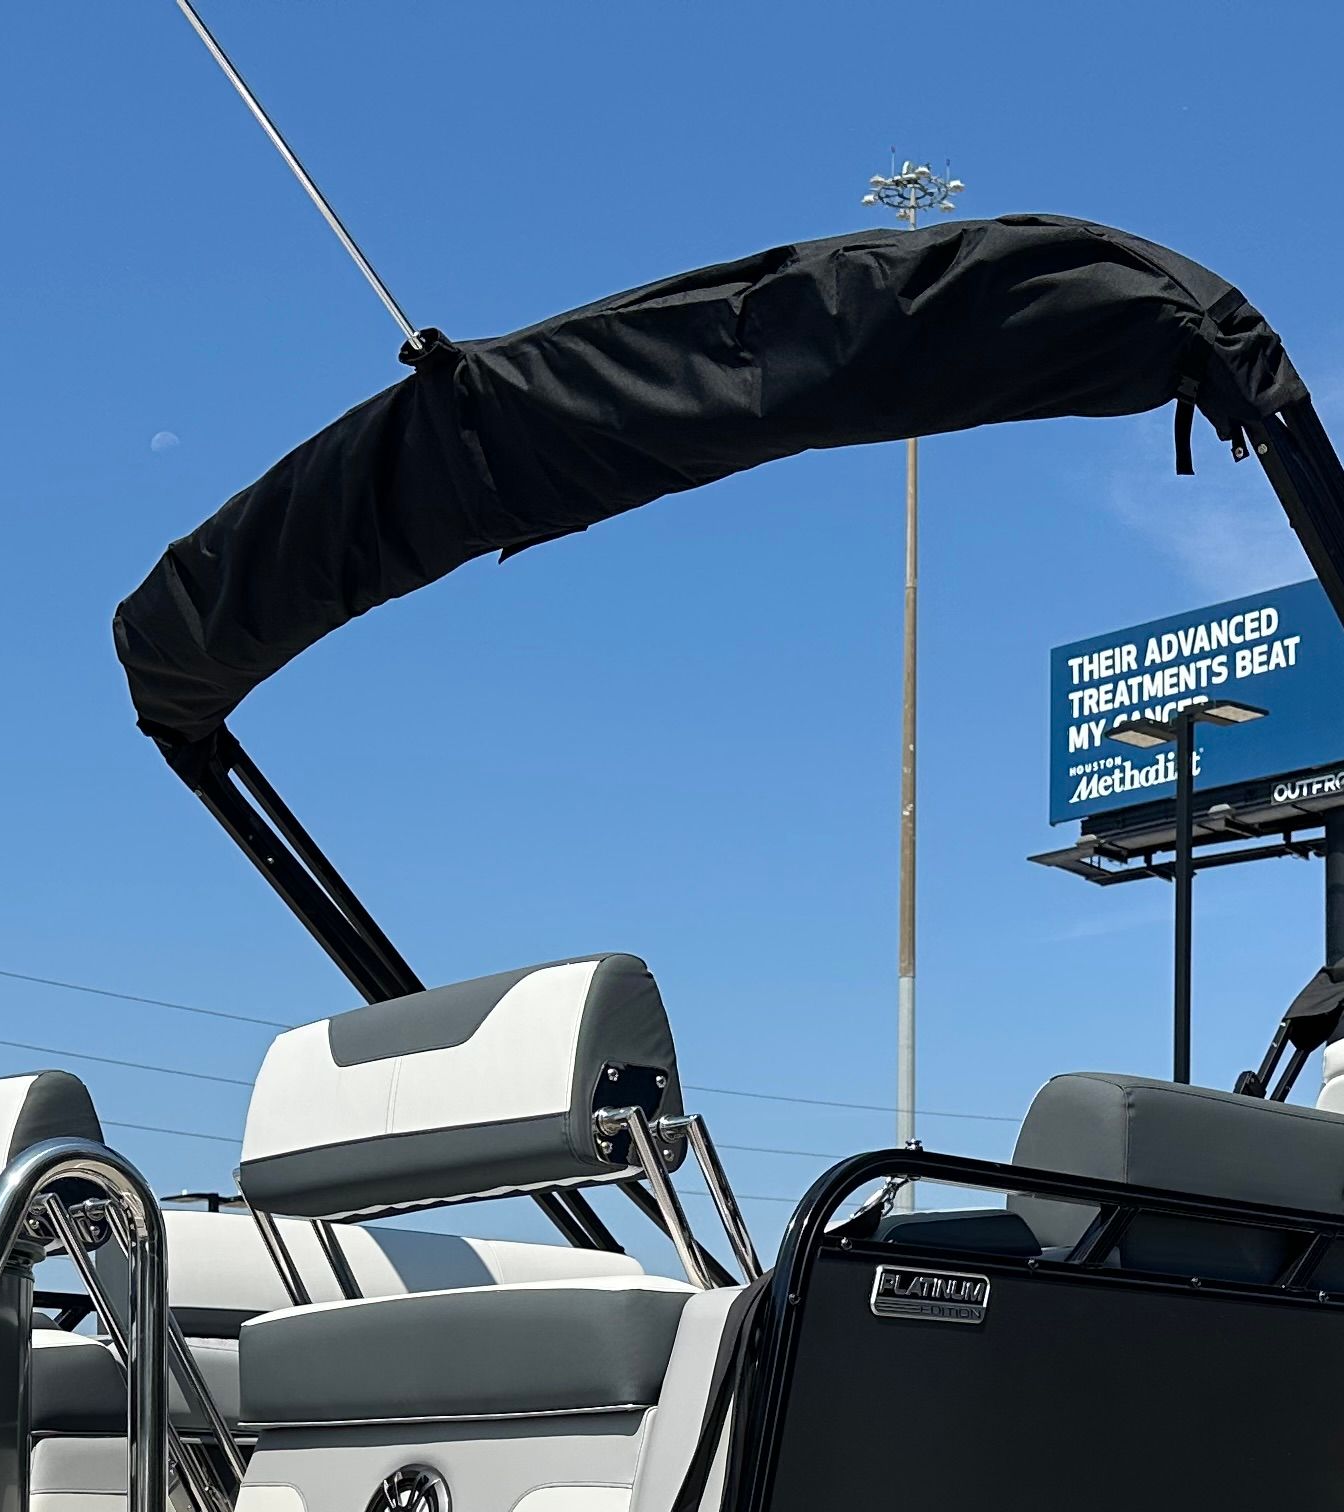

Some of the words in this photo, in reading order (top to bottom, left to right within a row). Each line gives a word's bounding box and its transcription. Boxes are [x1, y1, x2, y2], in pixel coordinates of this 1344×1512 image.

[1067, 644, 1138, 685] THEIR
[1144, 607, 1279, 667] ADVANCED
[1068, 654, 1229, 718] TREATMENTS
[1235, 636, 1301, 679] BEAT
[1068, 718, 1106, 753] MY
[1068, 751, 1202, 804] Methodit
[1069, 756, 1122, 777] HOUSTON
[879, 1273, 986, 1301] PLATINUM
[920, 1305, 982, 1319] EDITION
